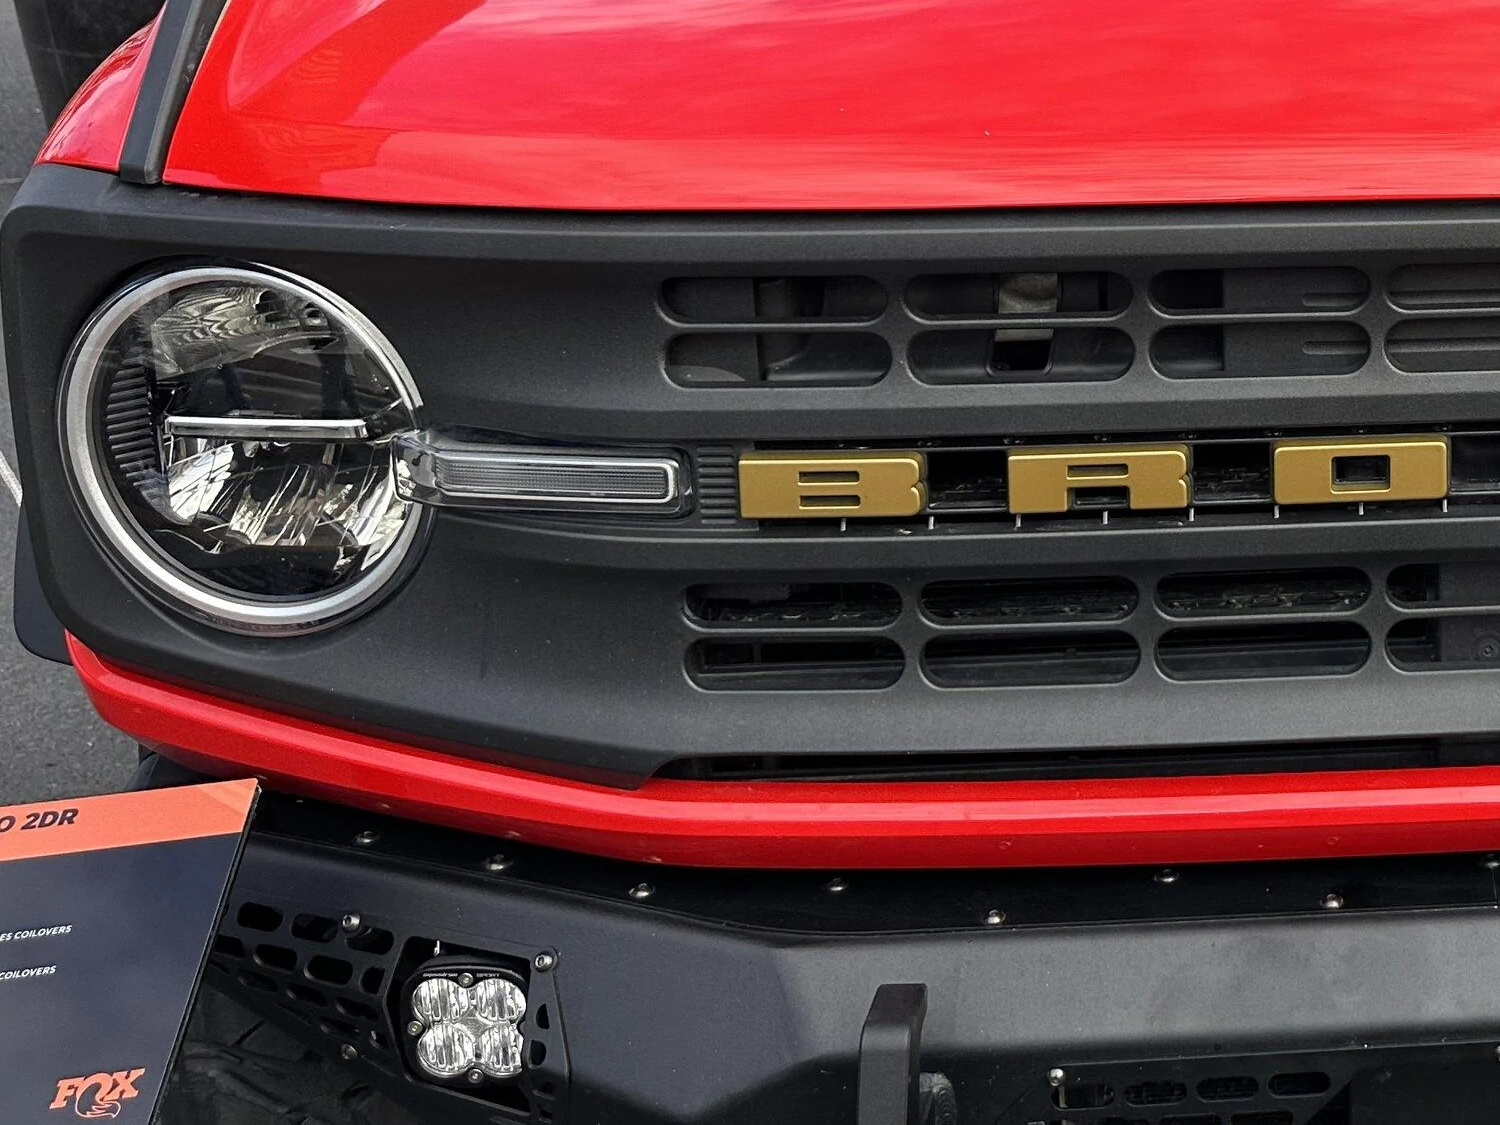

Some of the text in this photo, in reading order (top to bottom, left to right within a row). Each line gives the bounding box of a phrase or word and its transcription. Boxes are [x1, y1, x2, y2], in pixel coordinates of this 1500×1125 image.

[20, 808, 80, 831] 2DR
[14, 924, 73, 940] COILOVERS
[0, 965, 57, 980] COILOVERS
[49, 1068, 146, 1118] FOX
